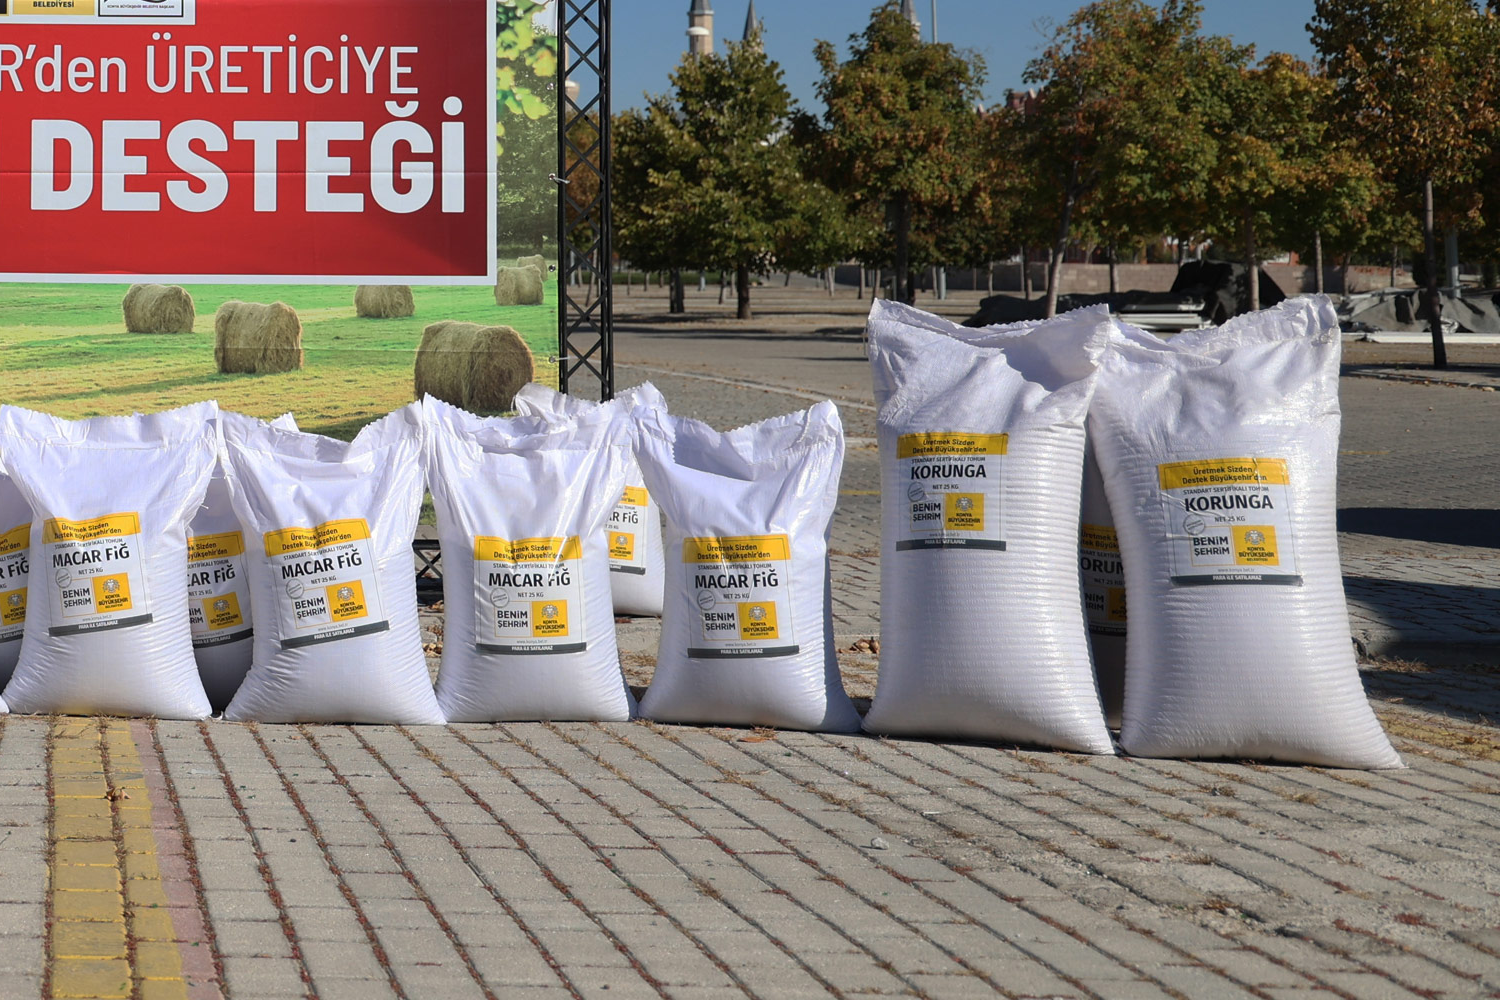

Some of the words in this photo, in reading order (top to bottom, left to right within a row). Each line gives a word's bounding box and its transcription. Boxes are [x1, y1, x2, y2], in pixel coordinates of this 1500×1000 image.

[33, 0, 74, 8] BELEDİYESİ
[146, 32, 419, 94] ÜRETİCİYE
[30, 96, 465, 214] DESTEĞİ
[913, 446, 933, 454] Destek
[911, 464, 987, 480] KORUNGA
[1193, 466, 1225, 475] Üretmek
[1184, 494, 1274, 512] KORUNGA
[88, 522, 108, 531] Sizden
[196, 542, 217, 550] Sizden
[282, 542, 303, 550] Destek
[53, 549, 102, 568] MACAR
[282, 558, 334, 580] MACAR
[489, 573, 543, 587] MACAR
[695, 574, 749, 589] MACAR
